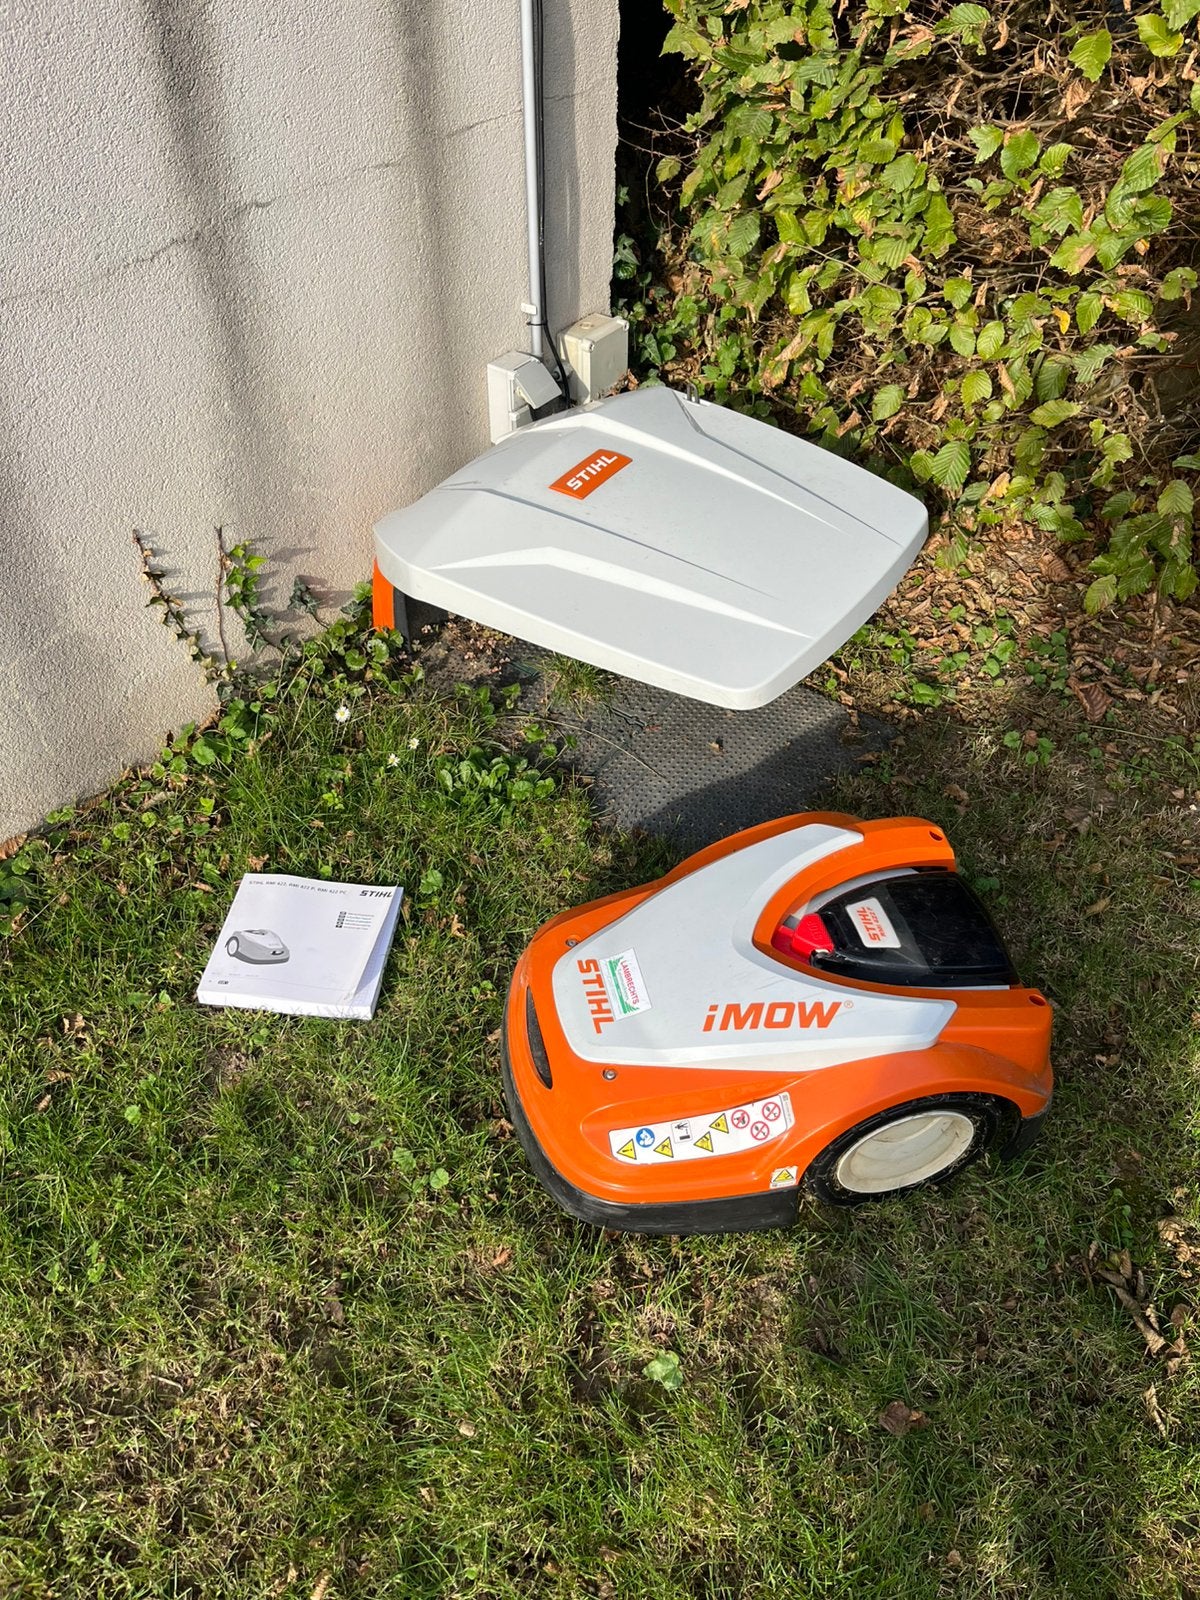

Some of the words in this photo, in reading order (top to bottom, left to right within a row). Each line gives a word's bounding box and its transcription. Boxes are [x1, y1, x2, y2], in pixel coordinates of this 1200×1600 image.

[566, 456, 618, 491] STIHL
[359, 889, 393, 898] STIHL
[857, 906, 881, 941] STIHL
[577, 959, 615, 1034] STIHL
[620, 960, 640, 1005] LAMBRECHTS
